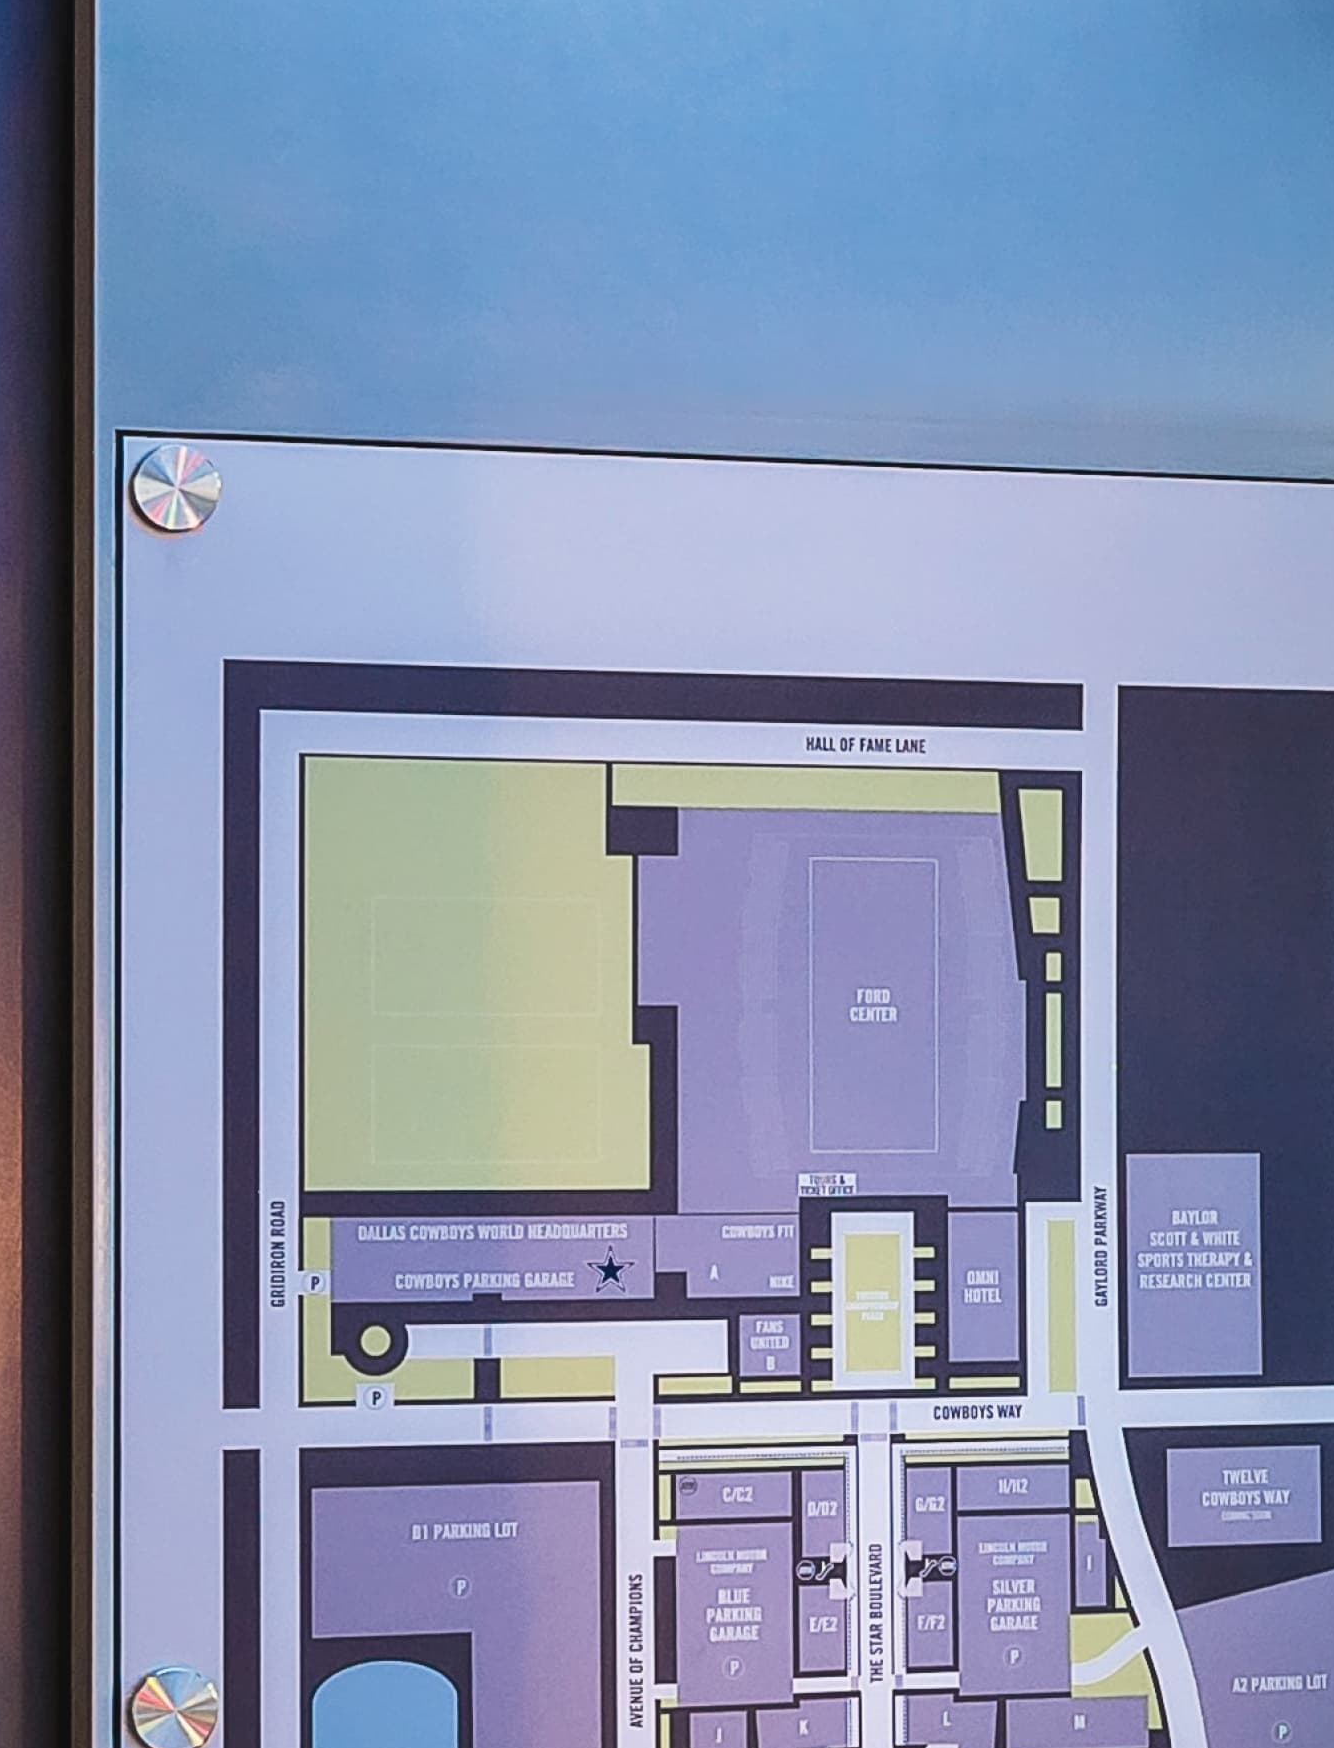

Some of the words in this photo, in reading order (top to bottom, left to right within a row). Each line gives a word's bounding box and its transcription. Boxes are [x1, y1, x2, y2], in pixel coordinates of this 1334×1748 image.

[806, 736, 835, 751] HALL
[840, 737, 856, 752] OF
[860, 738, 892, 753] FAME
[896, 738, 926, 754] LANE
[857, 989, 890, 1005] FORD
[850, 1006, 897, 1022] CENTER
[271, 1200, 285, 1238] ROAD
[1094, 1186, 1107, 1246] PARKWAY
[1172, 1211, 1217, 1225] BAYLOR
[359, 1225, 405, 1241] DALLAS
[410, 1225, 474, 1240] COWBOYS
[478, 1224, 524, 1240] WORLD
[528, 1224, 627, 1240] HEADQUARTERS
[722, 1226, 774, 1239] COWBOYS
[778, 1225, 794, 1238] FIT
[1150, 1232, 1187, 1246] SCOTT
[1191, 1232, 1199, 1246] &
[1202, 1231, 1240, 1246] WHITE
[1138, 1253, 1183, 1267] SPORTS
[1187, 1253, 1240, 1267] THERAPY
[1244, 1253, 1252, 1266] &
[271, 1241, 285, 1308] GRIDIRON
[710, 1266, 718, 1279] A
[967, 1270, 999, 1285] OMNI
[1095, 1249, 1108, 1308] GAYLORD
[311, 1276, 320, 1290] P
[395, 1274, 459, 1289] COWBOYS
[464, 1273, 520, 1288] PARKING
[525, 1272, 574, 1287] GARAGE
[770, 1276, 795, 1288] NIKE
[1140, 1274, 1202, 1289] RESEARCH
[1207, 1274, 1251, 1288] CENTER
[964, 1288, 1002, 1303] HOTEL
[756, 1321, 783, 1333] FANS
[751, 1337, 789, 1349] UNITED
[372, 1391, 381, 1405] P
[934, 1406, 994, 1420] COWBOYS
[997, 1405, 1022, 1419] WAY
[1223, 1469, 1268, 1484] TWELVE
[723, 1487, 753, 1502] C/C2
[1202, 1491, 1261, 1506] COWBOYS
[1264, 1490, 1290, 1505] WAY
[916, 1497, 945, 1512] G/G2
[434, 1522, 490, 1539] PARKING
[494, 1521, 518, 1537] LOT
[456, 1580, 467, 1596] P
[869, 1543, 883, 1619] BOULEVARD
[993, 1579, 1034, 1595] SILVER
[718, 1588, 750, 1604] BLUE
[629, 1573, 643, 1652] CHAMPIONS
[988, 1597, 1040, 1613] PARKING
[707, 1607, 762, 1623] PARKING
[918, 1615, 945, 1630] F/F2
[810, 1617, 837, 1633] E/E2
[991, 1616, 1038, 1631] GARAGE
[710, 1626, 759, 1641] GARAGE
[869, 1624, 883, 1655] STAR
[629, 1656, 643, 1673] OF
[1010, 1650, 1019, 1664] P
[730, 1661, 739, 1675] P
[869, 1659, 883, 1683] THE
[1232, 1679, 1248, 1693] A2
[1251, 1676, 1302, 1692] PARKING
[1307, 1674, 1327, 1689] LOT
[629, 1677, 643, 1729] AVENUE
[943, 1712, 951, 1726] L
[799, 1720, 809, 1735] K
[1278, 1726, 1287, 1739] P
